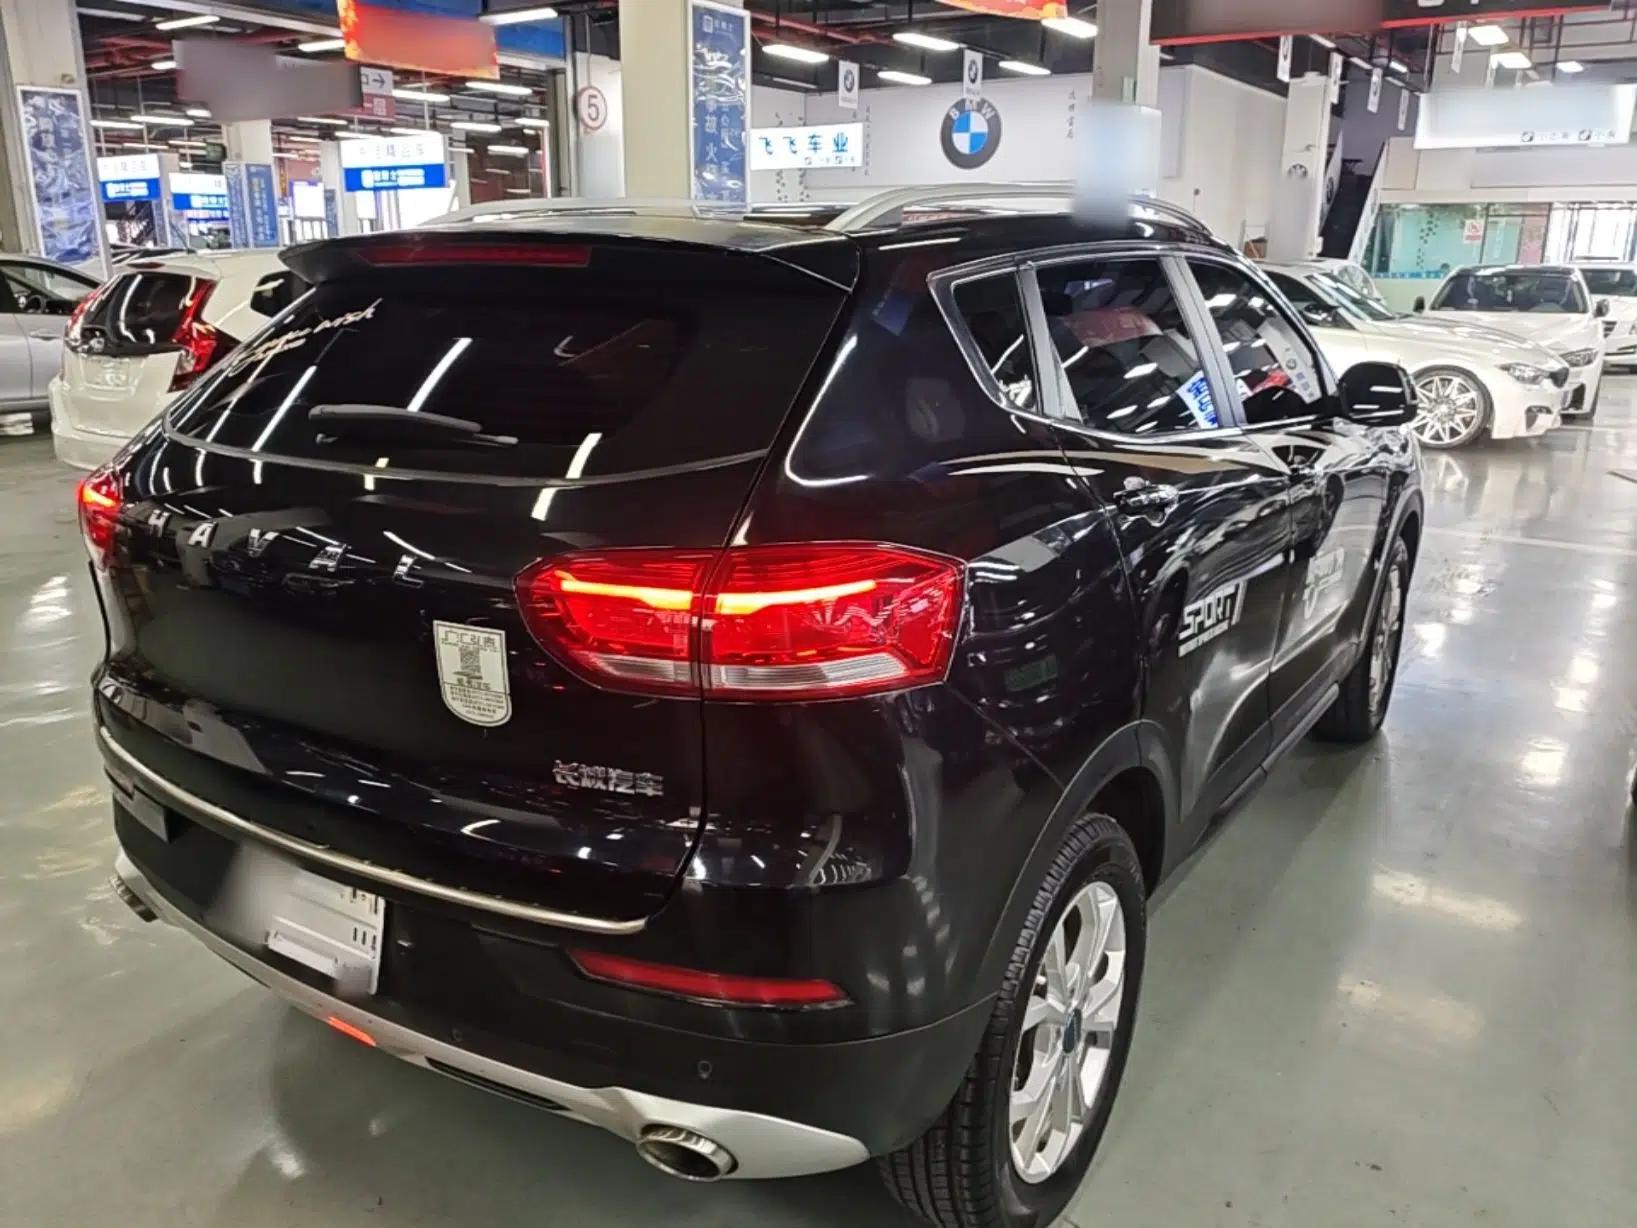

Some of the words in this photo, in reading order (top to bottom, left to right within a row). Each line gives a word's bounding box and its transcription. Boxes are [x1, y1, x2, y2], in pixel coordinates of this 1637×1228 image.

[588, 94, 600, 121] 5
[758, 132, 848, 155] 飞飞车业
[552, 759, 664, 796] 长城汽车
